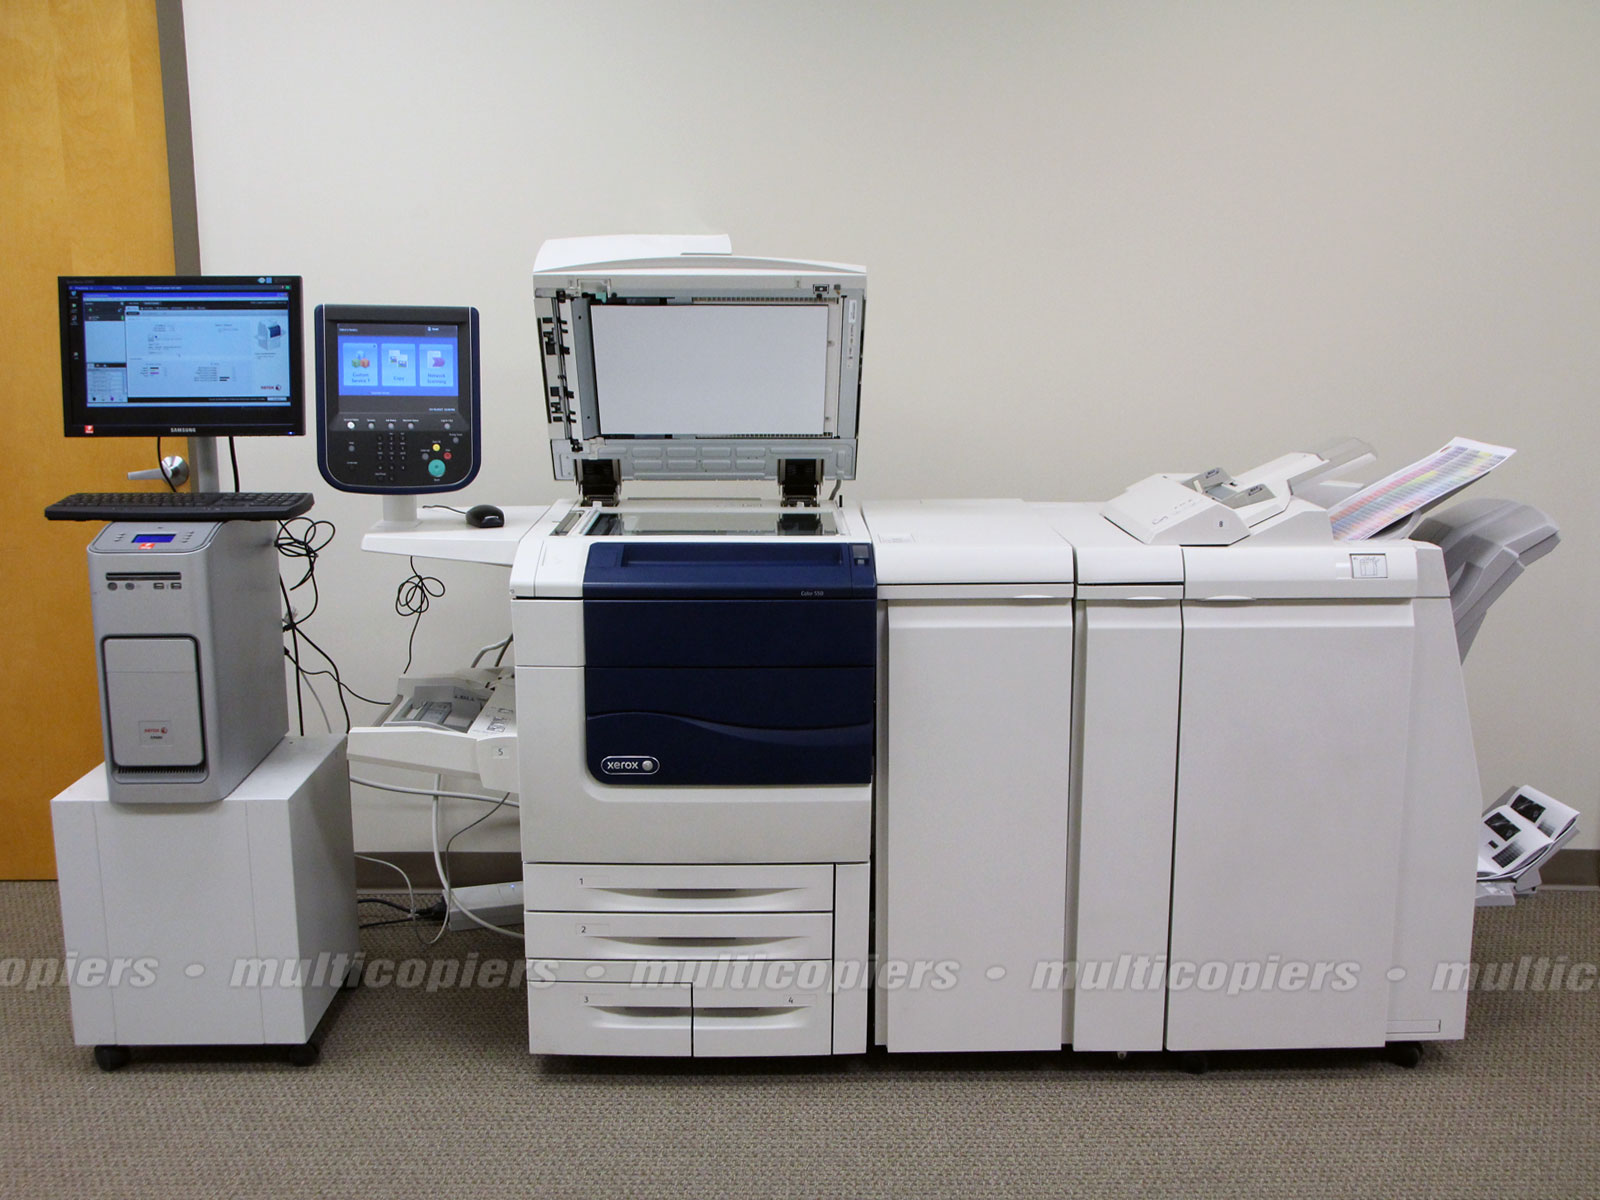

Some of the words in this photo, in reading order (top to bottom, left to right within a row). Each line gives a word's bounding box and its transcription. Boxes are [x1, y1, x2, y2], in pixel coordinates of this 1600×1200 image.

[498, 747, 504, 756] 5
[607, 761, 639, 770] xerox
[579, 877, 584, 885] 1
[581, 925, 587, 933] 2
[584, 996, 589, 1004] 3
[788, 996, 794, 1004] 4
